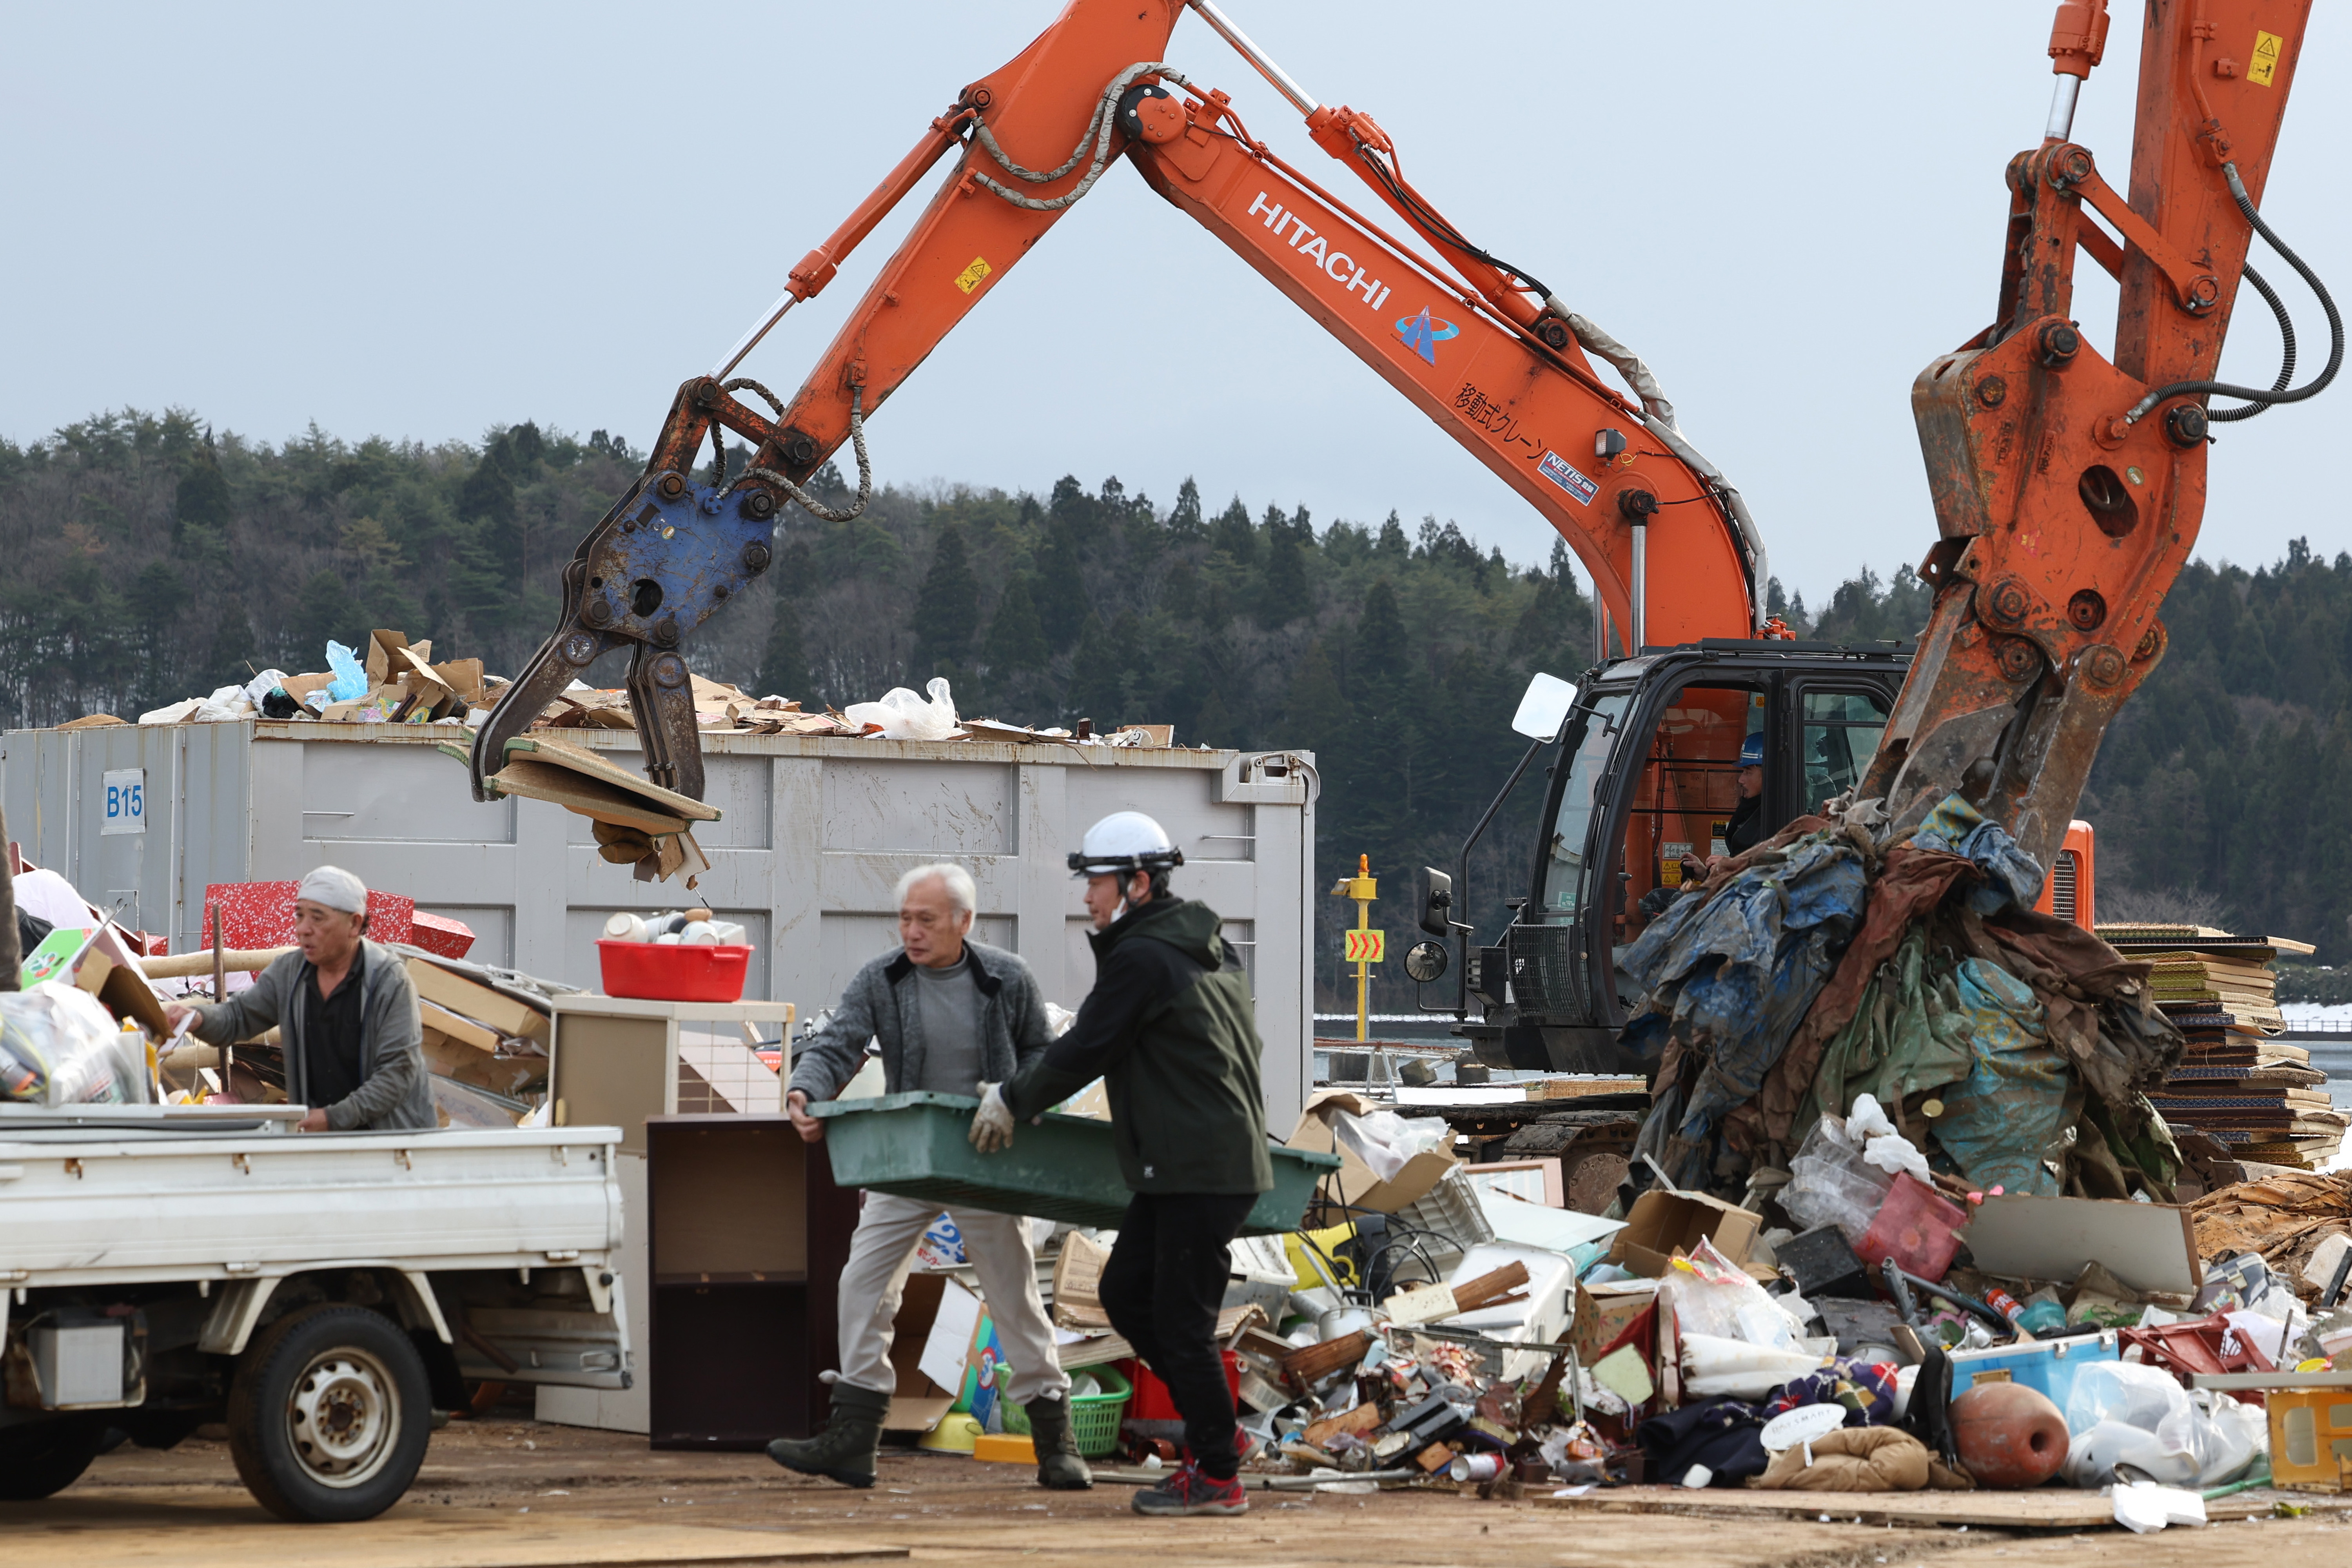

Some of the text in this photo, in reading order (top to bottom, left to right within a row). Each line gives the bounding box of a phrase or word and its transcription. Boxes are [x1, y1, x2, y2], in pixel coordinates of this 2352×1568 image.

[1248, 191, 1391, 311] HITACHI
[1400, 340, 1418, 355] Engineering
[1417, 354, 1434, 368] Corporation
[1455, 383, 1548, 459] 移動式クレーン
[1547, 455, 1585, 485] NETIS
[107, 785, 142, 817] B15
